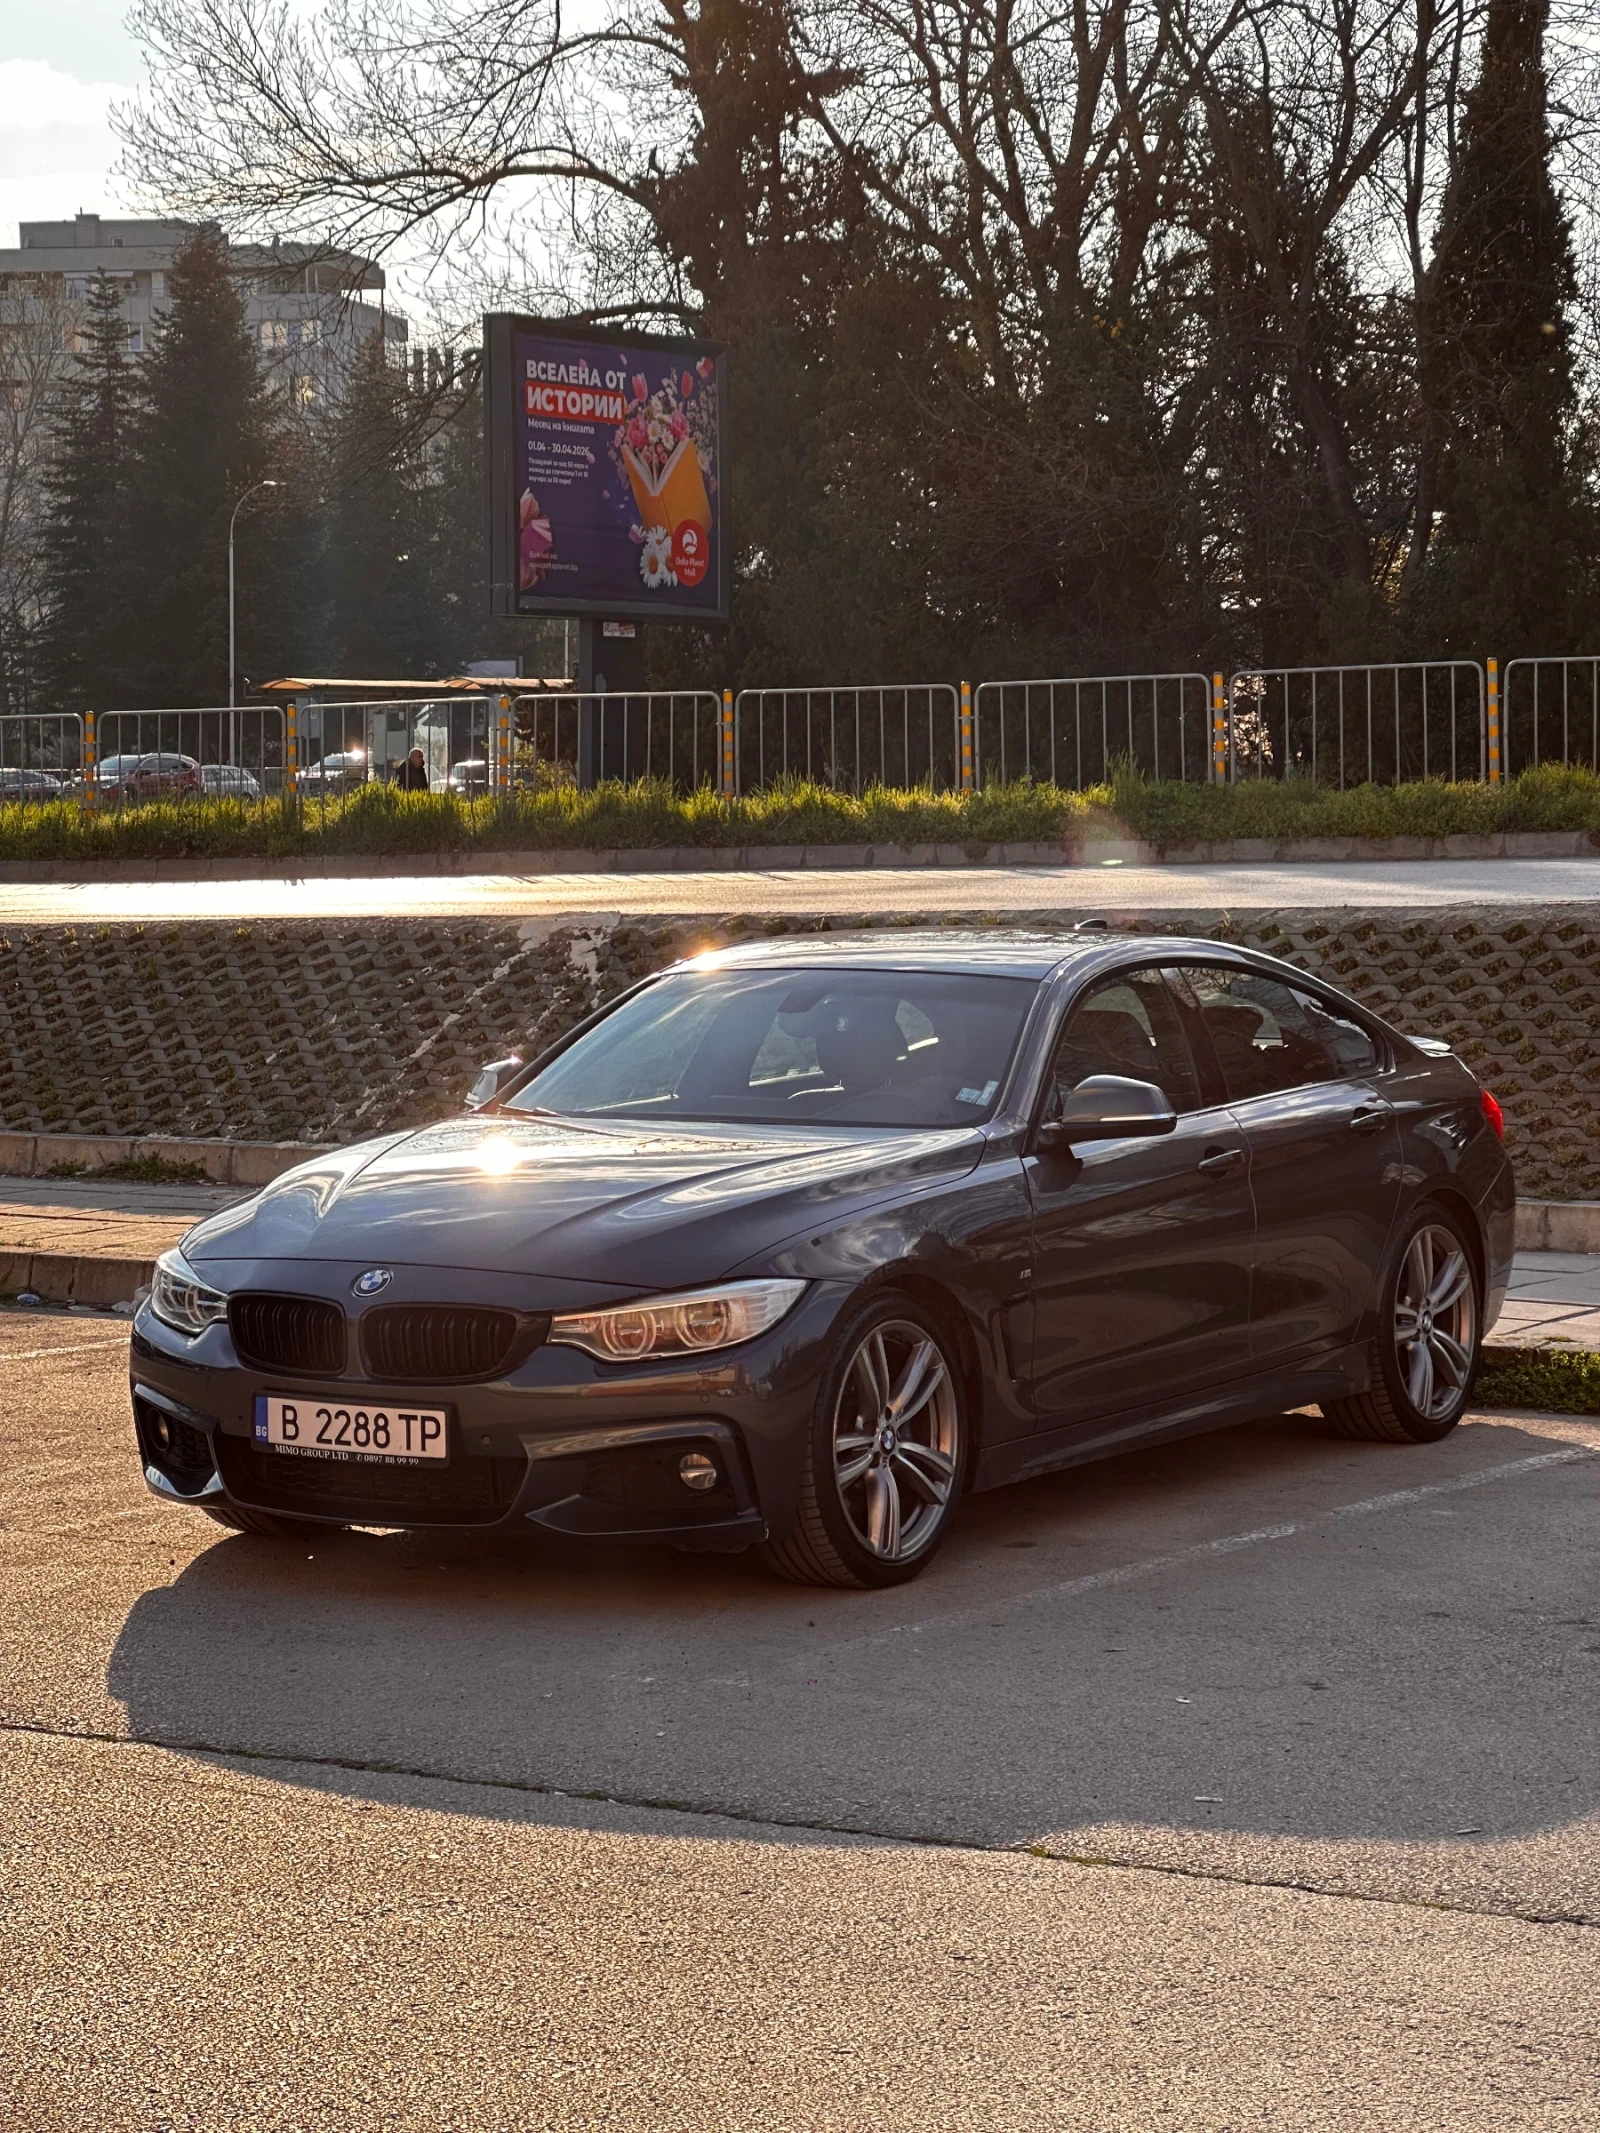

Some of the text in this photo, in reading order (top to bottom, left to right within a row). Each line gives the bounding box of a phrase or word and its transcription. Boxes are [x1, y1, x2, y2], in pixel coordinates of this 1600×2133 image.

[526, 359, 627, 390] ВСЕЛЕНА ОТ
[527, 386, 622, 419] ИСТОРИИ
[528, 418, 595, 435] Месец на книгата
[528, 440, 546, 452] 01.04
[255, 1425, 268, 1437] BG
[282, 1404, 442, 1452] B 2288 TP
[275, 1444, 419, 1466] MIMO GROUP LTD 0897 88 99 99
